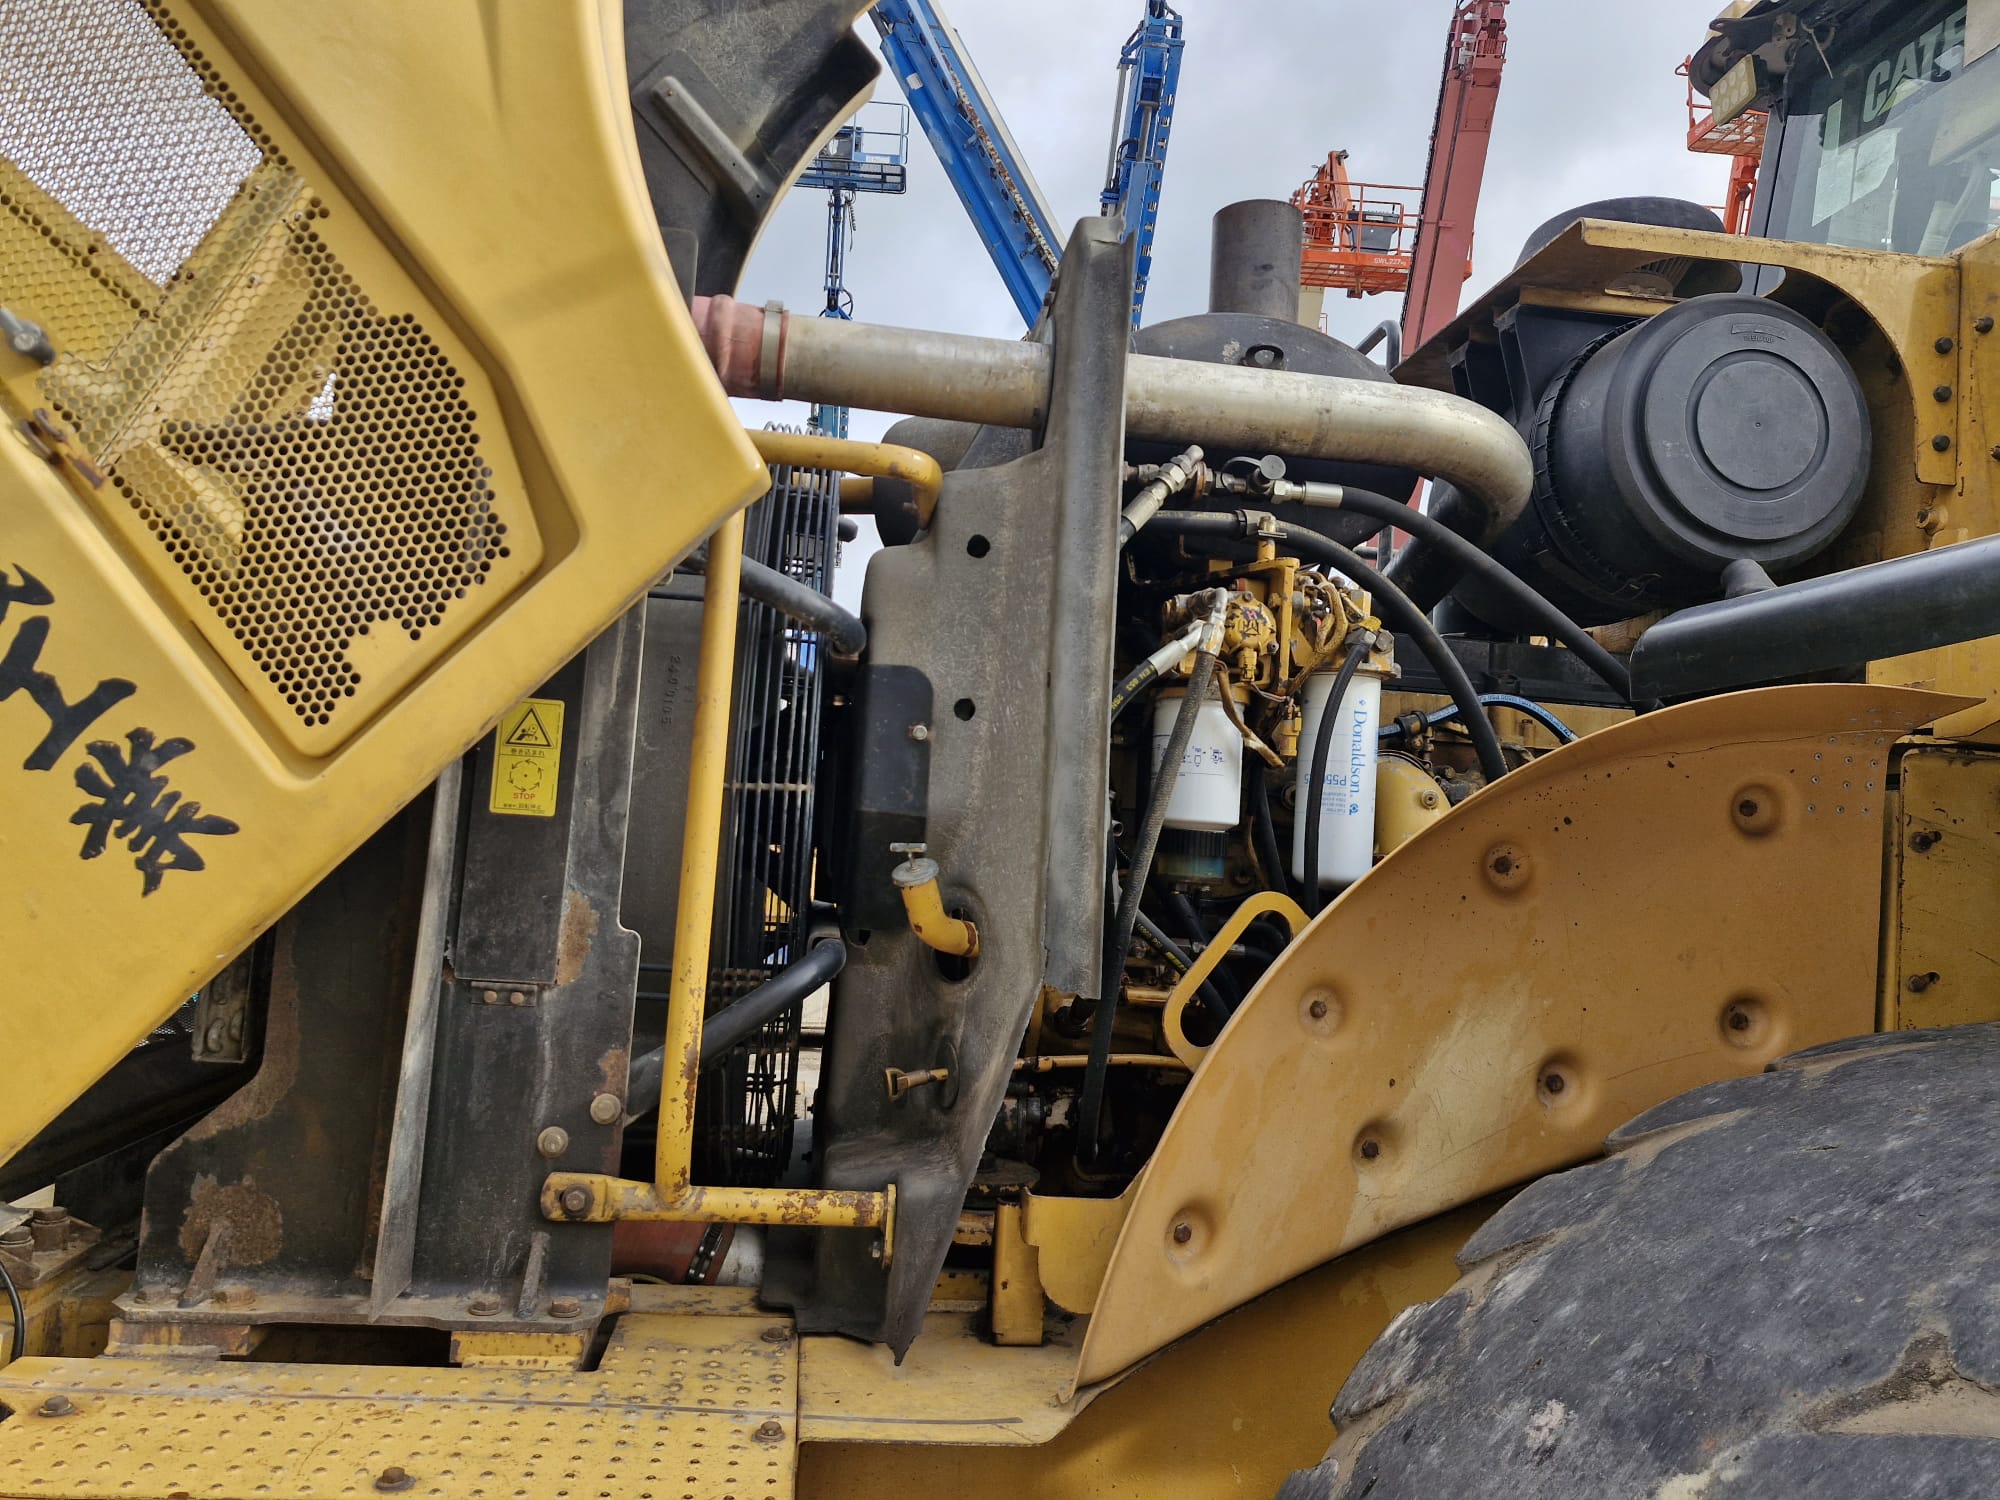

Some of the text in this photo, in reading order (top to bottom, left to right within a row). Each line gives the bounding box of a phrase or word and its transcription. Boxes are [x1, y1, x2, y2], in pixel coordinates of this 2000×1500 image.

[0, 563, 240, 898] 工業
[1350, 710, 1368, 793] Donaldson
[513, 792, 536, 800] STOP
